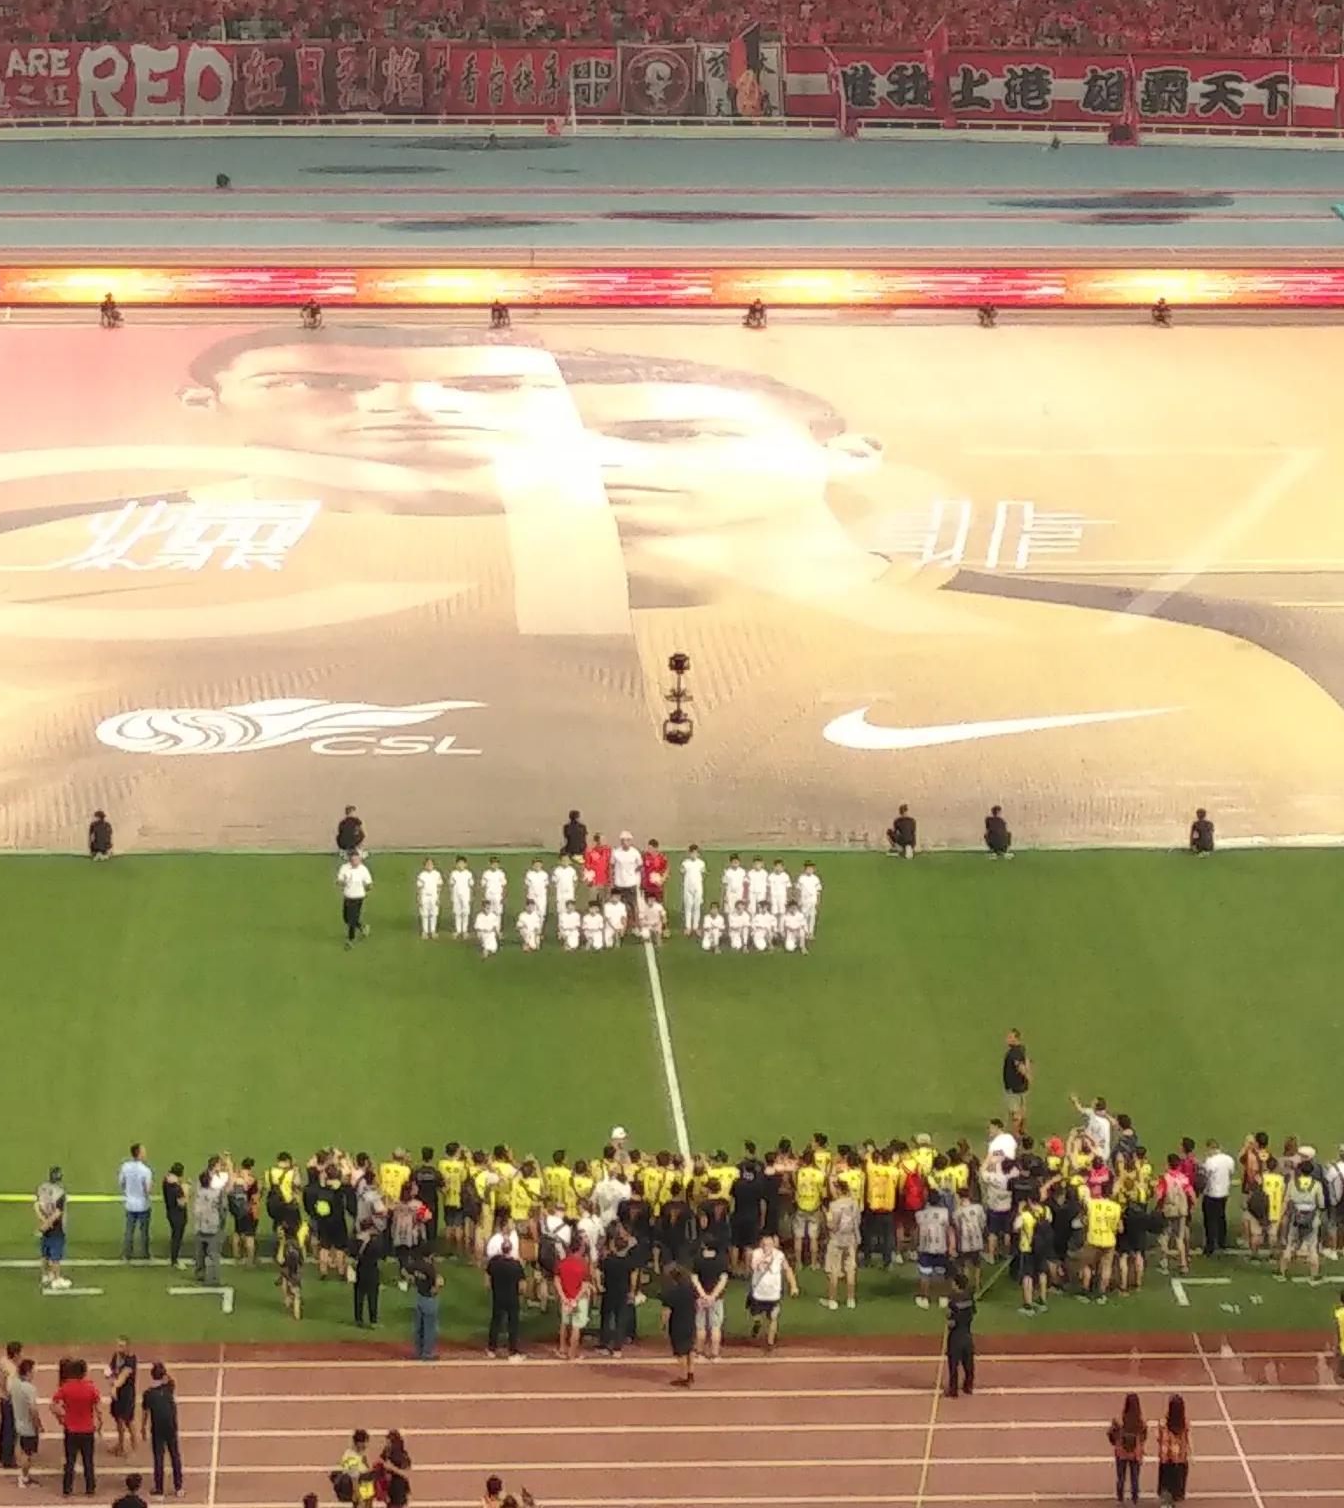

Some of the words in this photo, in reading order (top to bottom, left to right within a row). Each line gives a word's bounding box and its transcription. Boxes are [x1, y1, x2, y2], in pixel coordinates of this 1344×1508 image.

[6, 47, 72, 80] ARE
[77, 44, 233, 118] RED
[840, 62, 1055, 113] 唯我上港
[311, 735, 483, 756] CSL
